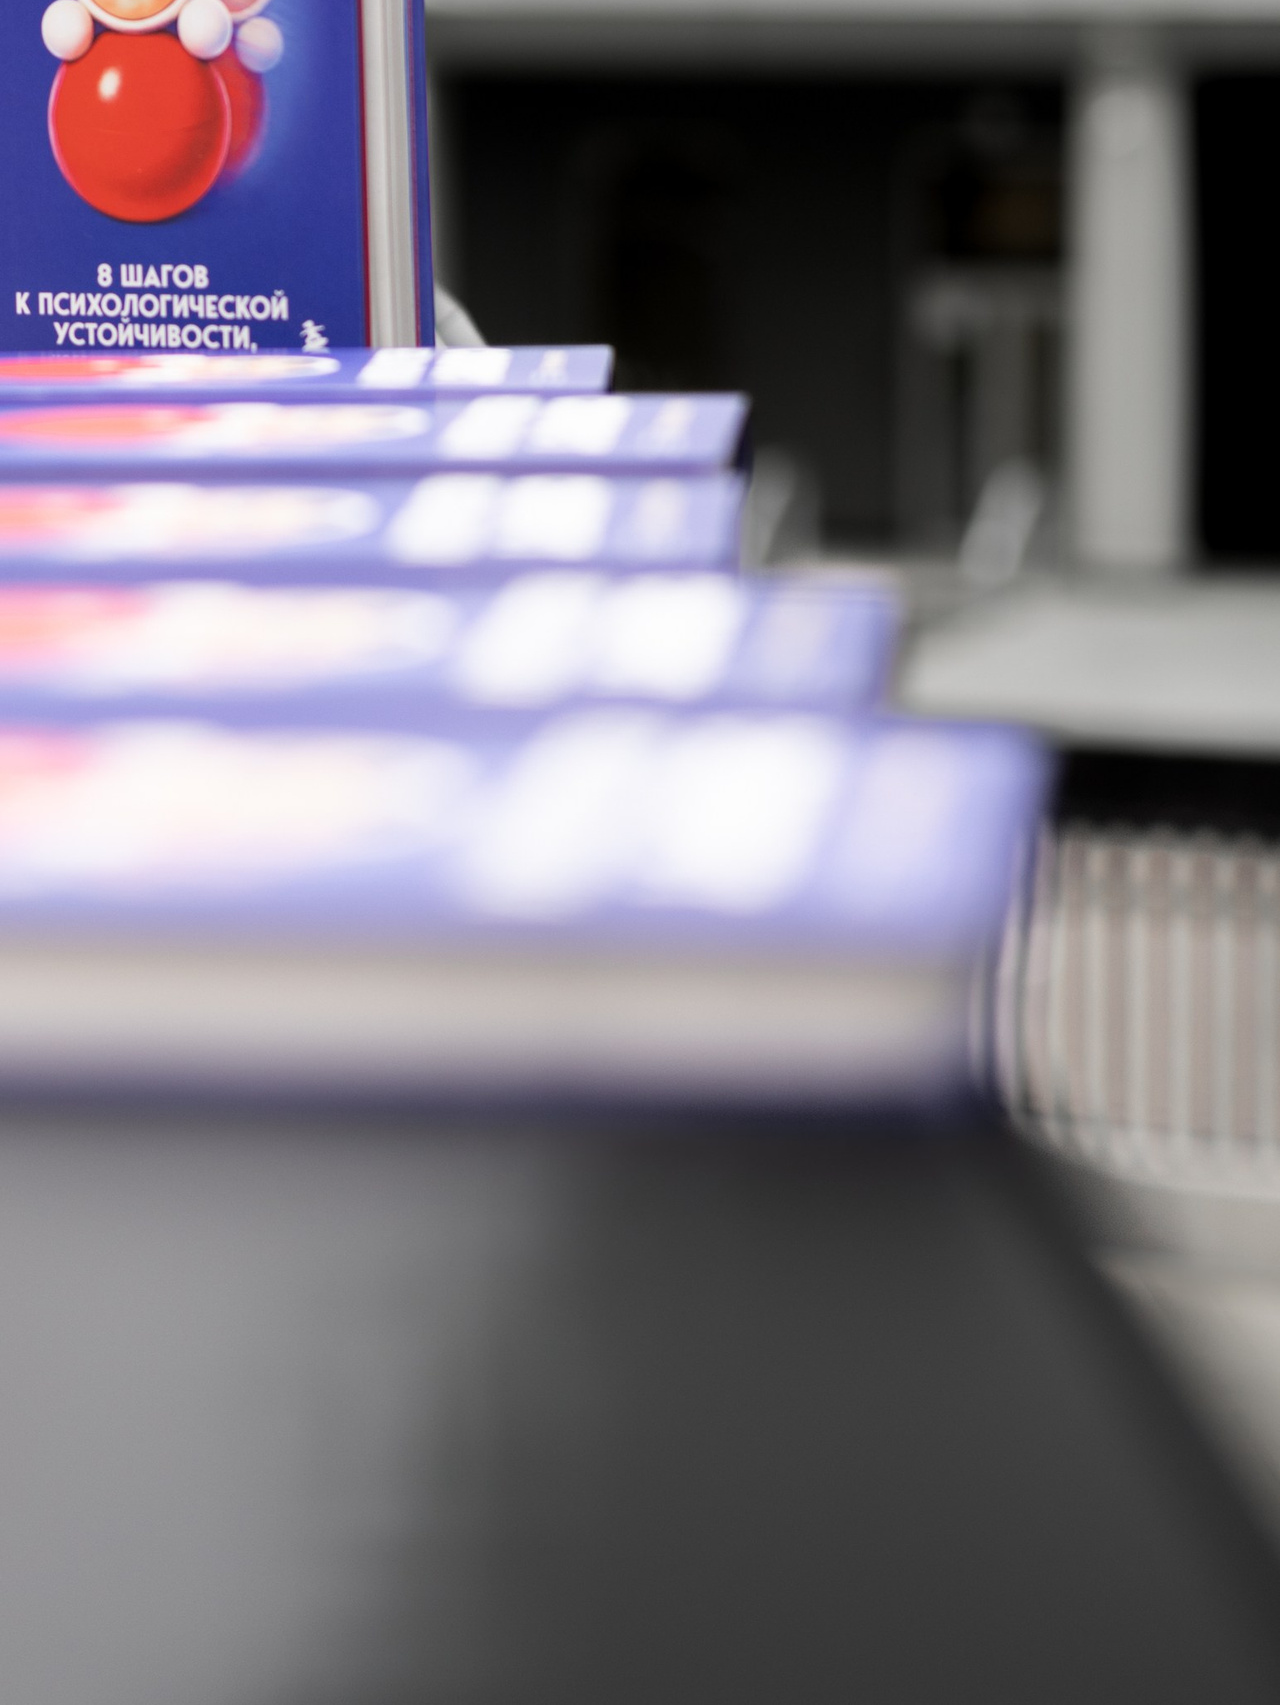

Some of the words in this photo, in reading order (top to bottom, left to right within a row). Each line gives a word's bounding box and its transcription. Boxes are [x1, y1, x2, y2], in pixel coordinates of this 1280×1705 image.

[97, 263, 113, 288] 8
[121, 264, 209, 289] ШАГОВ
[15, 291, 31, 315] К
[38, 290, 289, 321] ПСИХОЛОГИЧЕСКОЙ
[54, 318, 258, 352] УСТОЙЧИВОСТИ,
